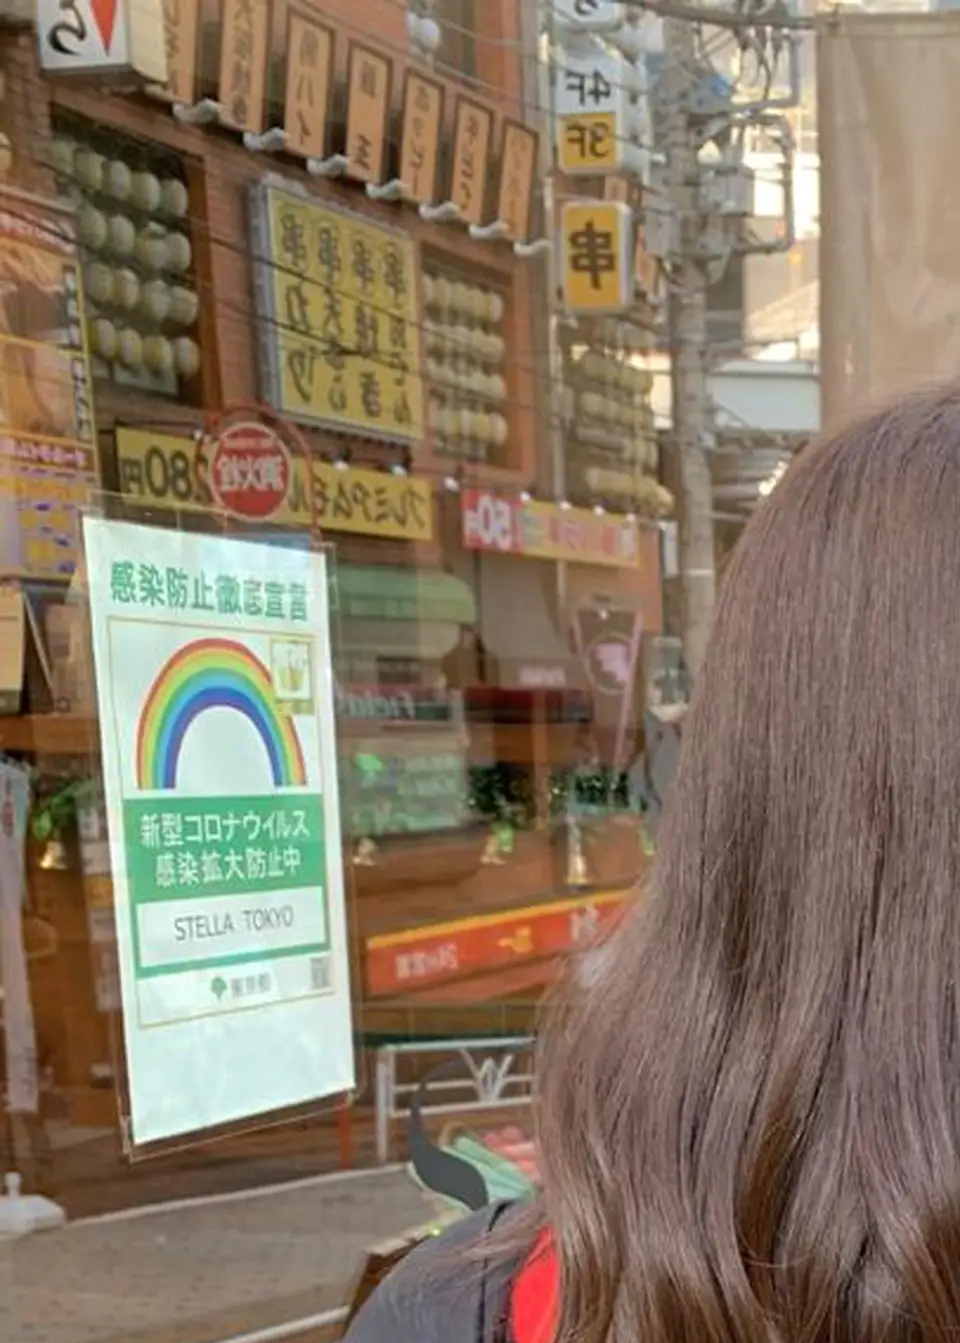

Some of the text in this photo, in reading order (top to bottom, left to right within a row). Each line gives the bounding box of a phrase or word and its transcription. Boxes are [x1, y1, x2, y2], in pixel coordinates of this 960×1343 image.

[109, 561, 308, 622] 感染防止徹底宣言
[140, 809, 311, 850] 新型コロナウイルス
[155, 845, 302, 890] 感染拡大防止中
[174, 904, 294, 942] STELLA TOKYO
